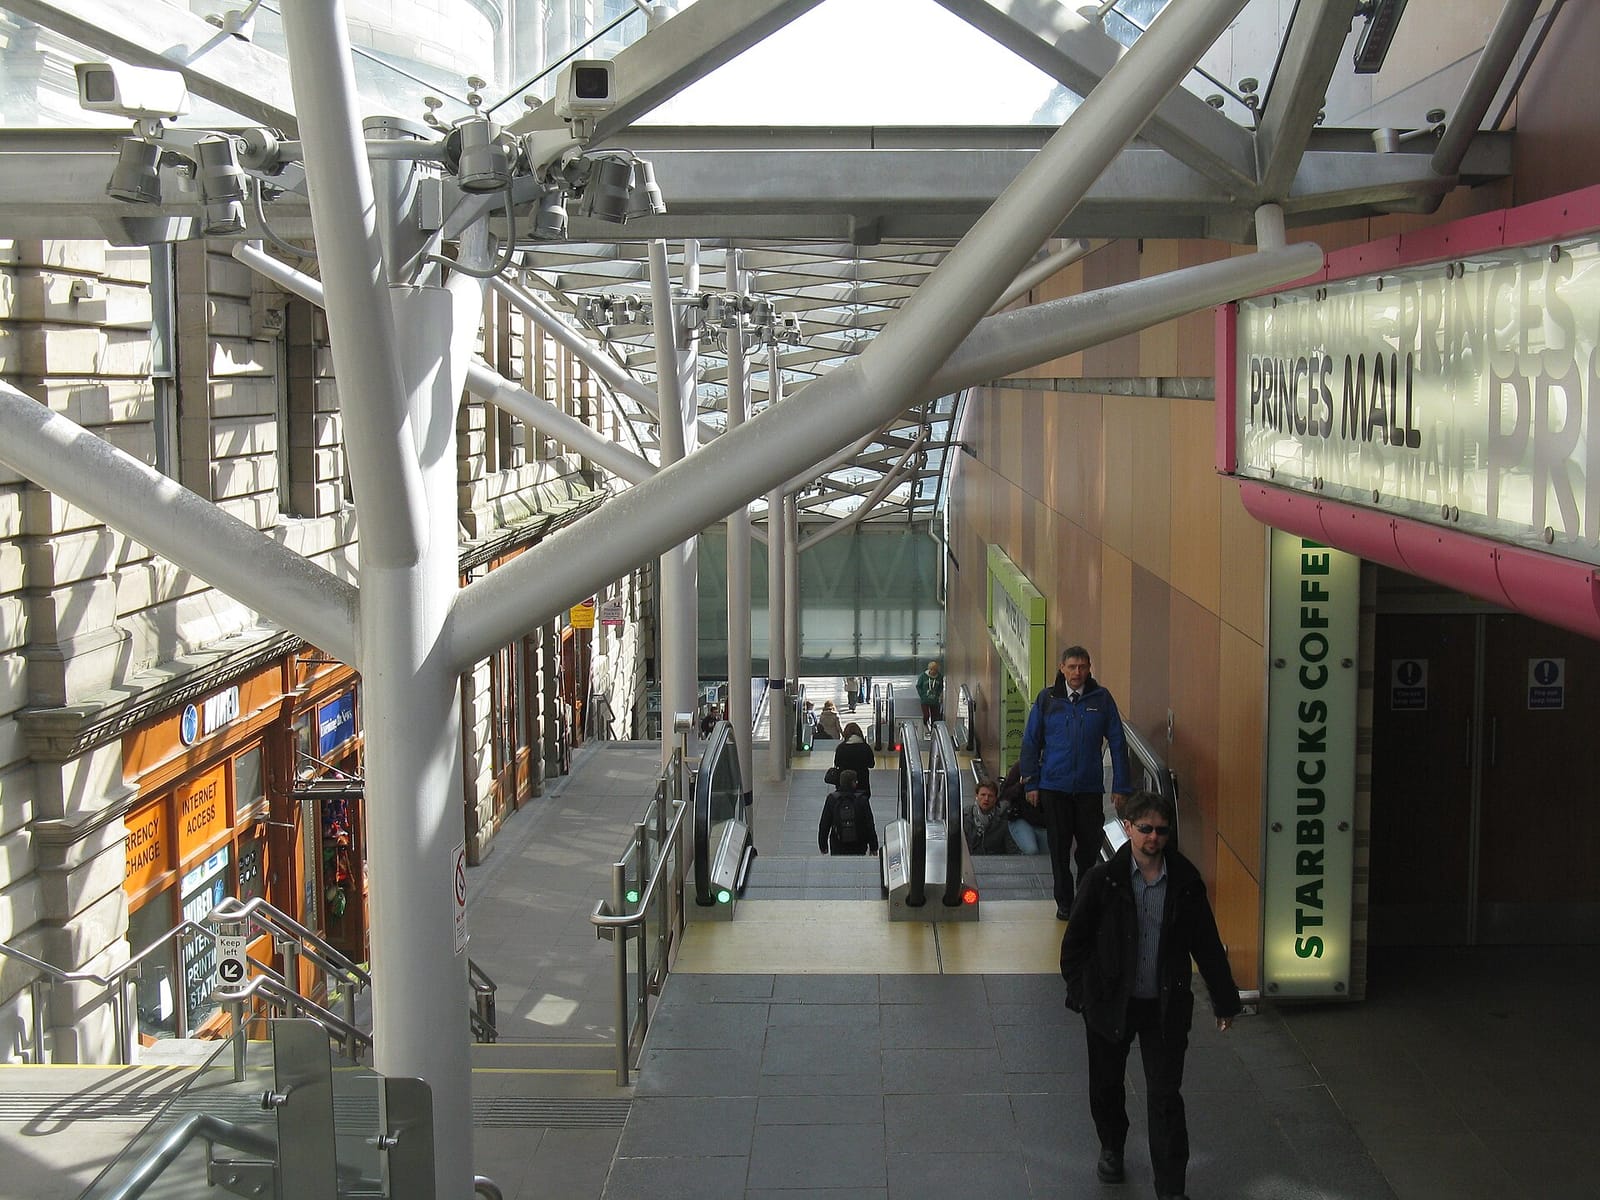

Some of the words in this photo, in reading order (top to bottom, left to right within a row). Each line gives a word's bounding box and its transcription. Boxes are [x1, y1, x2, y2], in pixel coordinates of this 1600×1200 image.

[1250, 355, 1334, 440] PRINCES
[1341, 351, 1421, 449] MALL
[1299, 539, 1330, 690] COFFE
[204, 685, 240, 735] WIRED
[182, 781, 217, 817] INTERNET
[186, 803, 216, 838] ACCESS
[1295, 699, 1328, 959] STARBUCKS
[183, 887, 213, 925] WIRED
[220, 938, 241, 948] Keep
[223, 948, 238, 956] left
